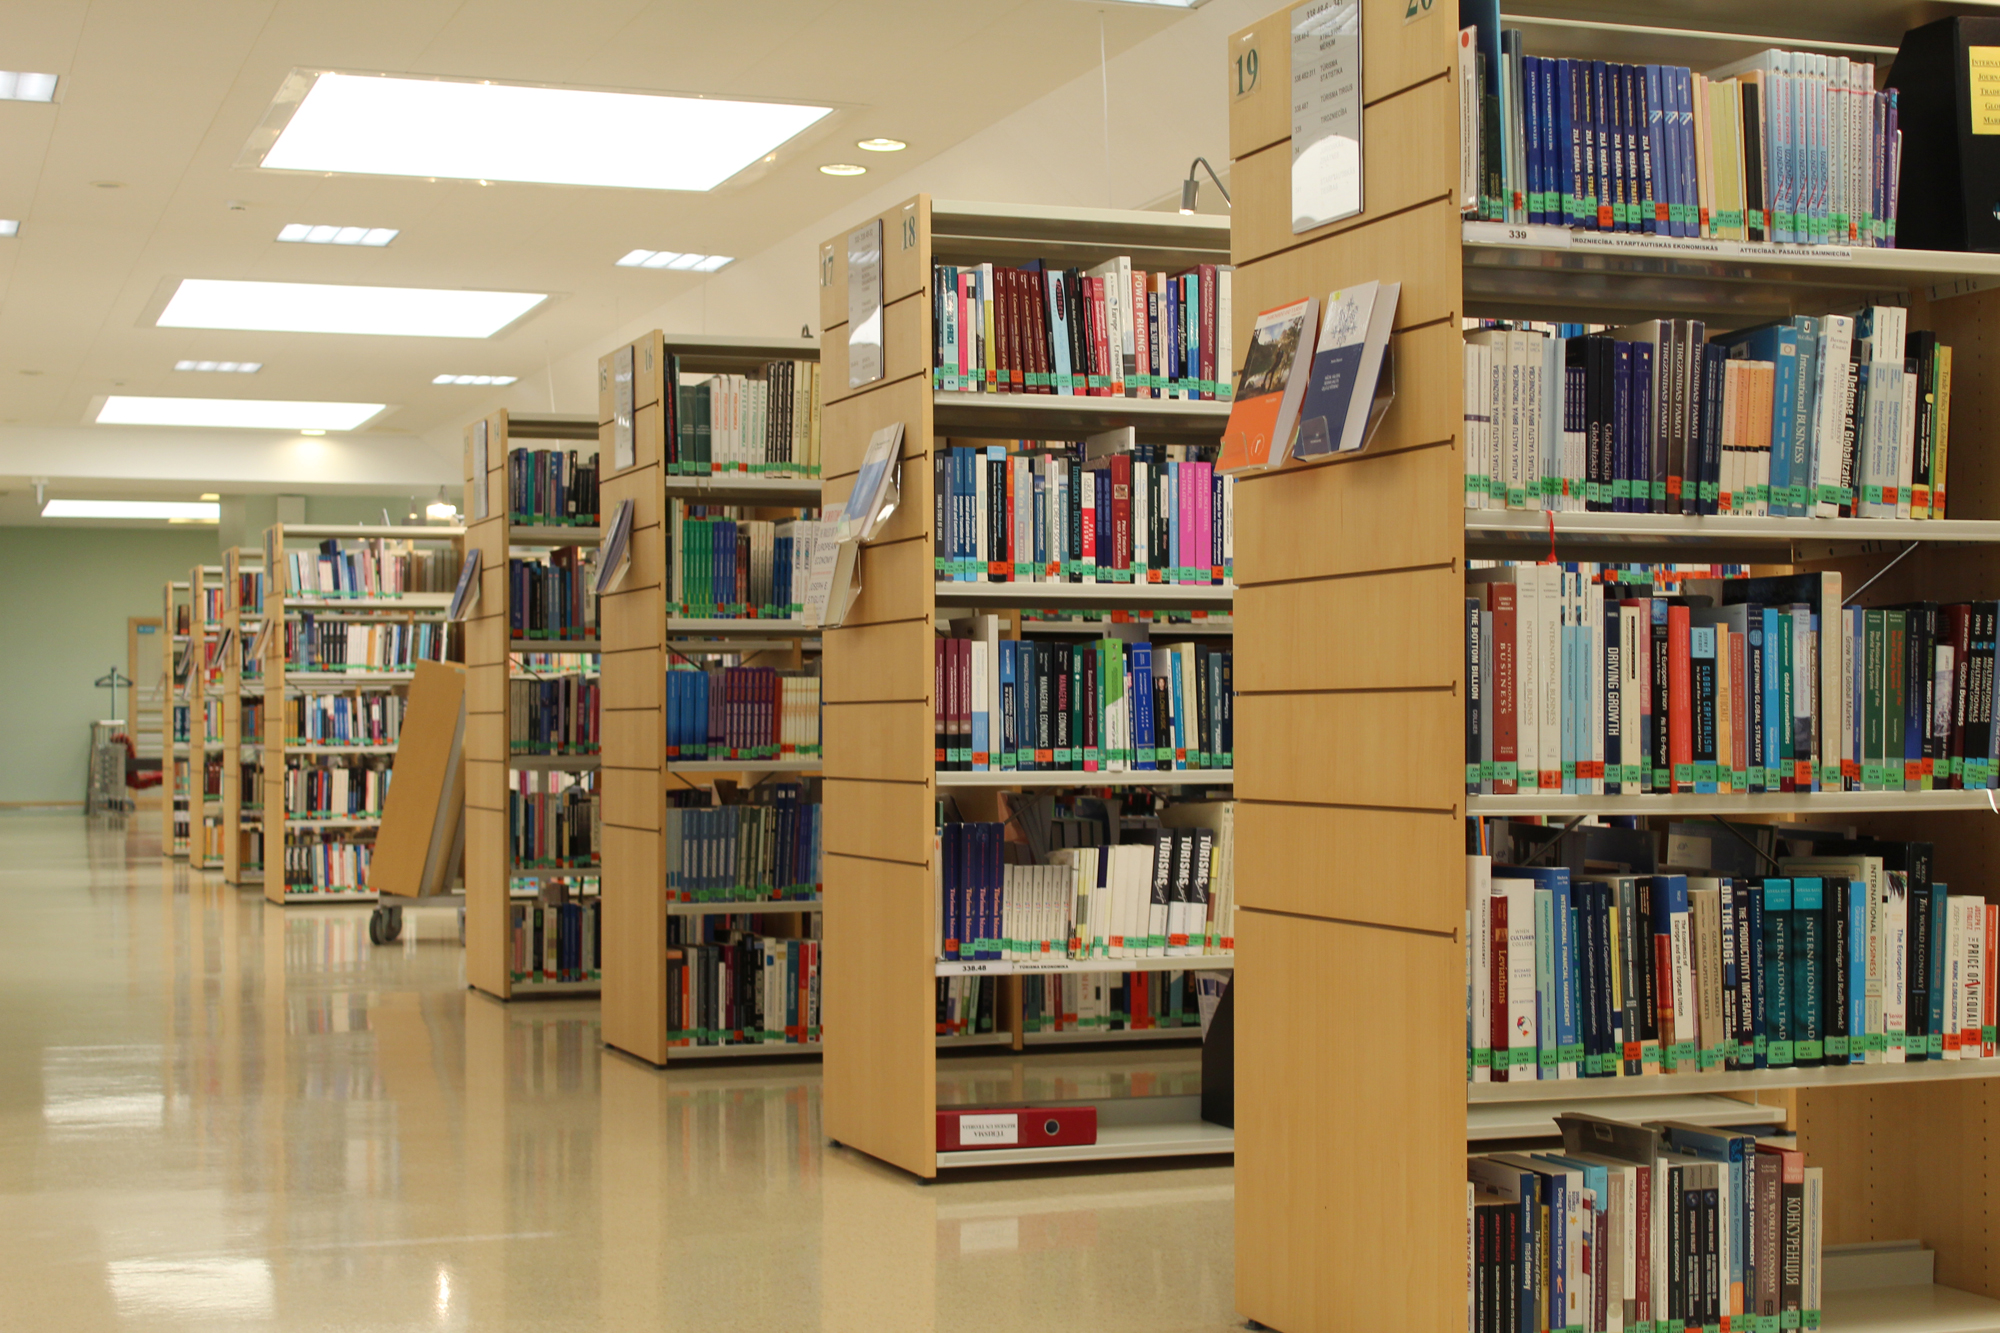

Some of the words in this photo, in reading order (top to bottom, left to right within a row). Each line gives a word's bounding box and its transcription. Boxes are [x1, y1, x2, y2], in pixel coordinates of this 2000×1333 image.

[1235, 48, 1259, 97] 19
[1320, 67, 1343, 82] STATISTIKA
[1572, 129, 1580, 143] ZILĀ
[903, 216, 916, 251] 18
[1509, 230, 1527, 239] 339
[1616, 240, 1672, 249] STARPTAUTISKĀS
[1673, 243, 1718, 251] EKONOMISKĀS
[823, 256, 834, 287] 17
[1135, 275, 1144, 309] POWER
[1111, 308, 1119, 331] Europe
[1136, 312, 1145, 352] PRICING
[644, 347, 653, 371] 16
[1692, 343, 1701, 402] TIRGZINĪBAS
[1849, 362, 1858, 372] In
[600, 368, 607, 392] 15
[1796, 354, 1809, 412] International
[1845, 375, 1858, 415] Defense
[1836, 392, 1844, 445] MANAGEMENT
[1940, 392, 1948, 412] Policy
[1691, 404, 1699, 439] PAMATI
[1845, 418, 1855, 429] of
[1590, 421, 1599, 479] Globalizācija
[1603, 423, 1612, 480] Globalizācija
[1794, 414, 1807, 464] BUSINESS
[1938, 448, 1946, 473] Poverty
[1073, 511, 1081, 554] Innovation
[1844, 636, 1852, 656] Grow
[1607, 647, 1619, 690] DRIVING
[1959, 662, 1967, 688] Global
[1059, 674, 1067, 711] MANAGERIAL
[1984, 657, 1993, 723] MULTINATIONALS
[1608, 692, 1619, 736] GROWTH
[1957, 689, 1966, 726] Business
[1040, 714, 1048, 748] ECONOMICS
[1058, 712, 1067, 745] ECONOMICS
[1178, 837, 1192, 885] TŪRISMS
[1197, 836, 1211, 884] TŪRISMS
[1722, 885, 1733, 904] ON
[1919, 897, 1928, 913] THE
[1560, 894, 1568, 945] INTERNATIONAL
[1722, 908, 1733, 931] THE
[1738, 907, 1747, 919] THE
[1918, 915, 1926, 943] WORLD
[1561, 946, 1569, 980] FINANCIAL
[1723, 934, 1733, 965] EDGE
[1739, 921, 1751, 980] PRODUCTIVITY
[1756, 939, 1764, 967] Global
[1776, 918, 1785, 1006] INTERNATIONAL
[1836, 940, 1844, 967] Foreign
[1895, 944, 1903, 981] European
[1498, 950, 1507, 1004] Leviathans
[1917, 945, 1925, 989] ECONOMY
[1562, 981, 1570, 1027] MANAGEMENT
[1742, 982, 1752, 1031] IMPERATIVE
[1836, 983, 1844, 1004] Really
[1768, 1180, 1776, 1200] THE
[1784, 1197, 1800, 1285] КОНКУРЕНЦИЯ
[1523, 1262, 1532, 1290] money
